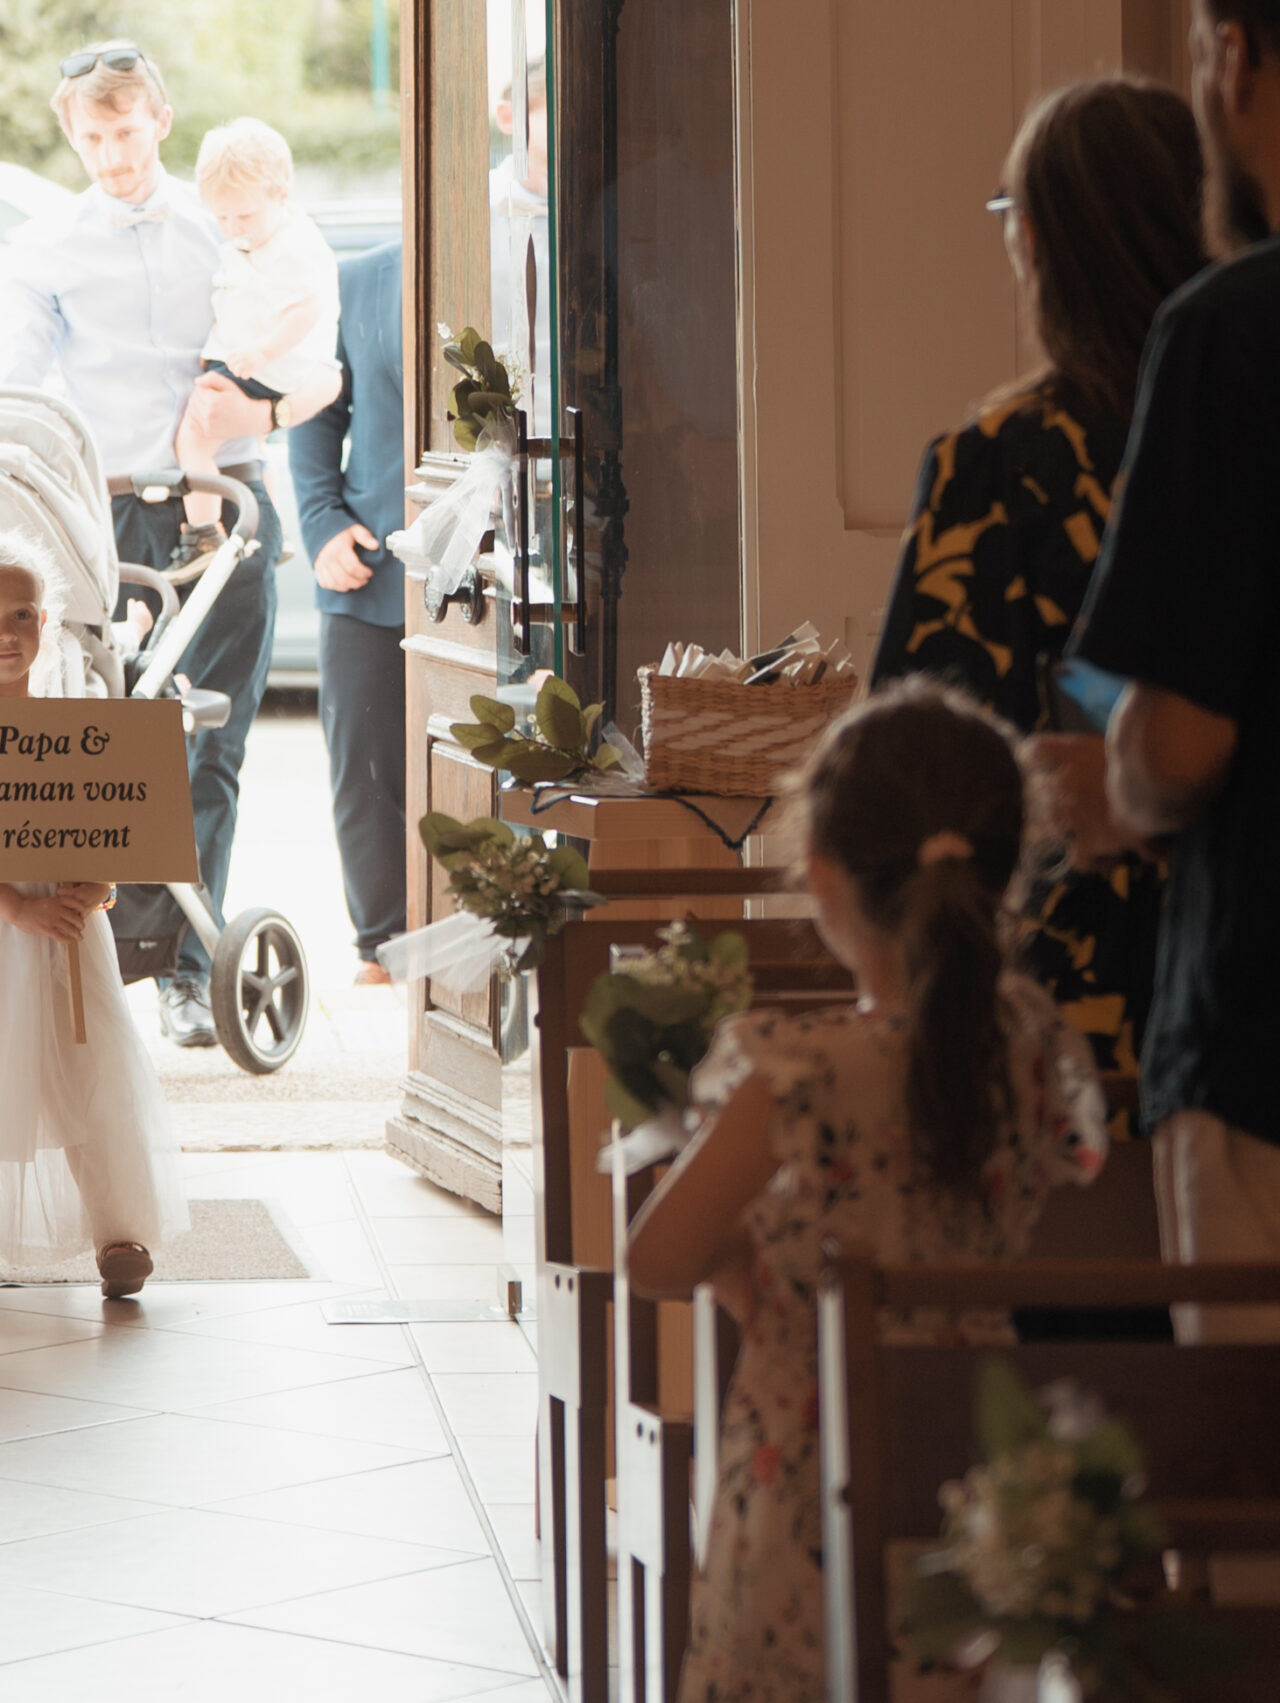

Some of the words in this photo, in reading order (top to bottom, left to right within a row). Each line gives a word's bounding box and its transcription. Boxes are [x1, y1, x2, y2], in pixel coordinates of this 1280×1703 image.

[80, 725, 111, 756] &
[82, 781, 147, 802] vous
[2, 819, 131, 849] réservent
